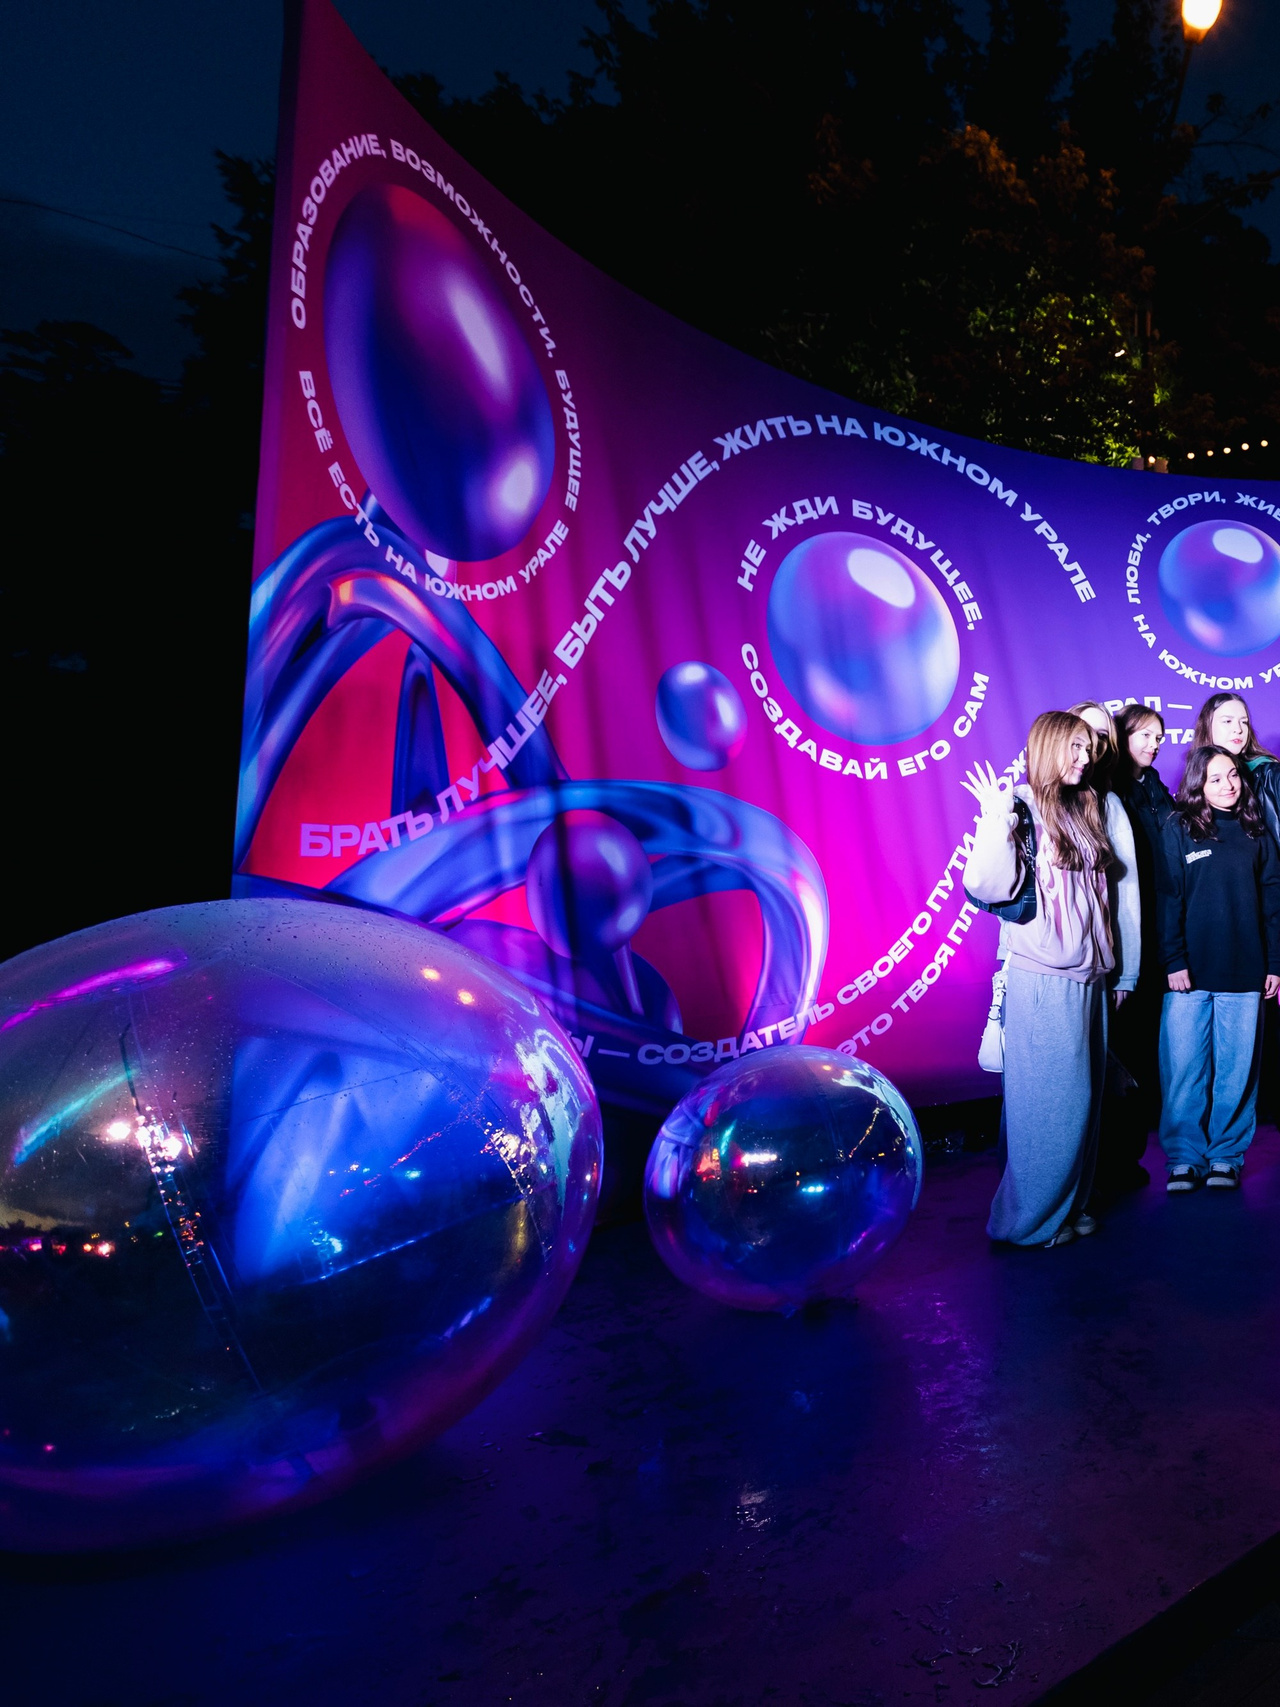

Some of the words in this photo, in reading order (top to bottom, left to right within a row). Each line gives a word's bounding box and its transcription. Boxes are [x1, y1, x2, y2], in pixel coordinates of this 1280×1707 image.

[291, 133, 387, 330] ОБРАЗОВАНИЕ,
[555, 370, 582, 511] БУДУЩЕЕ
[299, 370, 333, 454] ВСЁ
[328, 461, 380, 547] ЕСТЬ
[385, 546, 417, 584] НА
[425, 573, 518, 601] ЮЖНОМ
[518, 519, 569, 584] УРАЛЕ
[1126, 532, 1152, 605] ЛЮБИ,
[1147, 491, 1226, 526] ТВОРИ,
[300, 810, 434, 857] БРАТЬ
[437, 669, 568, 822] ЛУЧШЕЕ,
[553, 560, 633, 670] БЫТЬ
[623, 450, 721, 563] ЛУЧШЕ,
[713, 415, 812, 460] ЖИТЬ
[815, 414, 867, 439] НА
[873, 421, 1019, 508] ЮЖНОМ
[1020, 502, 1096, 603] УРАЛЕ
[737, 539, 766, 592] НЕ
[761, 496, 840, 540] ЖДИ
[852, 499, 983, 631] БУДУЩЕЕ,
[741, 643, 888, 780] СОЗДАВАЙ
[898, 740, 951, 777] ЕГО
[953, 672, 990, 738] САМ
[1133, 614, 1157, 649] НА
[1158, 649, 1254, 690] ЮЖНОМ
[637, 1003, 834, 1065] СОЗДАТЕЛЬ
[836, 911, 932, 1005] СВОЕГО
[835, 1013, 893, 1056] ЭТО
[891, 942, 956, 1013] ТВОЯ
[946, 901, 979, 945] ПЛ
